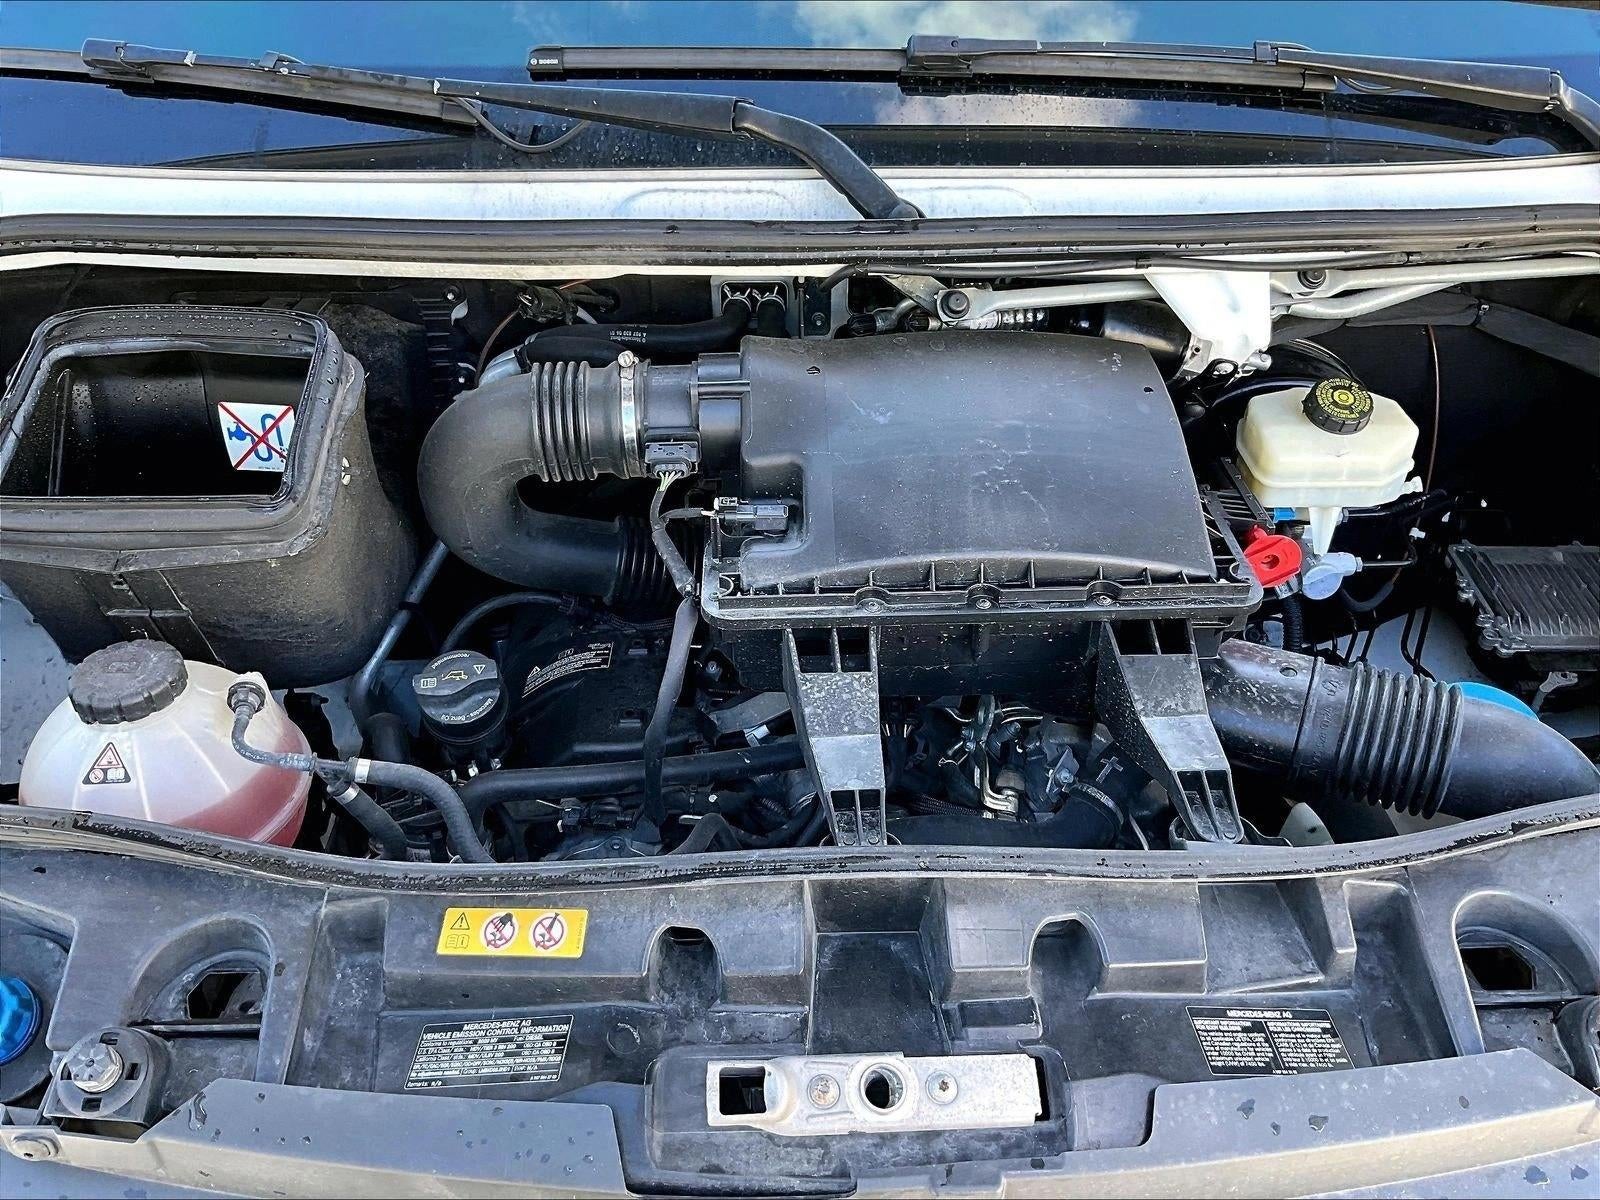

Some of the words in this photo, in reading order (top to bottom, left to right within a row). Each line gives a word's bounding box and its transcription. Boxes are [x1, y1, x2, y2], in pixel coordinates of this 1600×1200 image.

[431, 653, 471, 669] recommended
[1226, 1010, 1282, 1018] MERCEDES-BENZ
[463, 1021, 521, 1030] MERCEDES-BENZ
[422, 1032, 452, 1040] VEHICLE
[452, 1030, 486, 1038] EMISSION
[486, 1028, 520, 1036] CONTROL
[520, 1025, 569, 1034] INFORMATION
